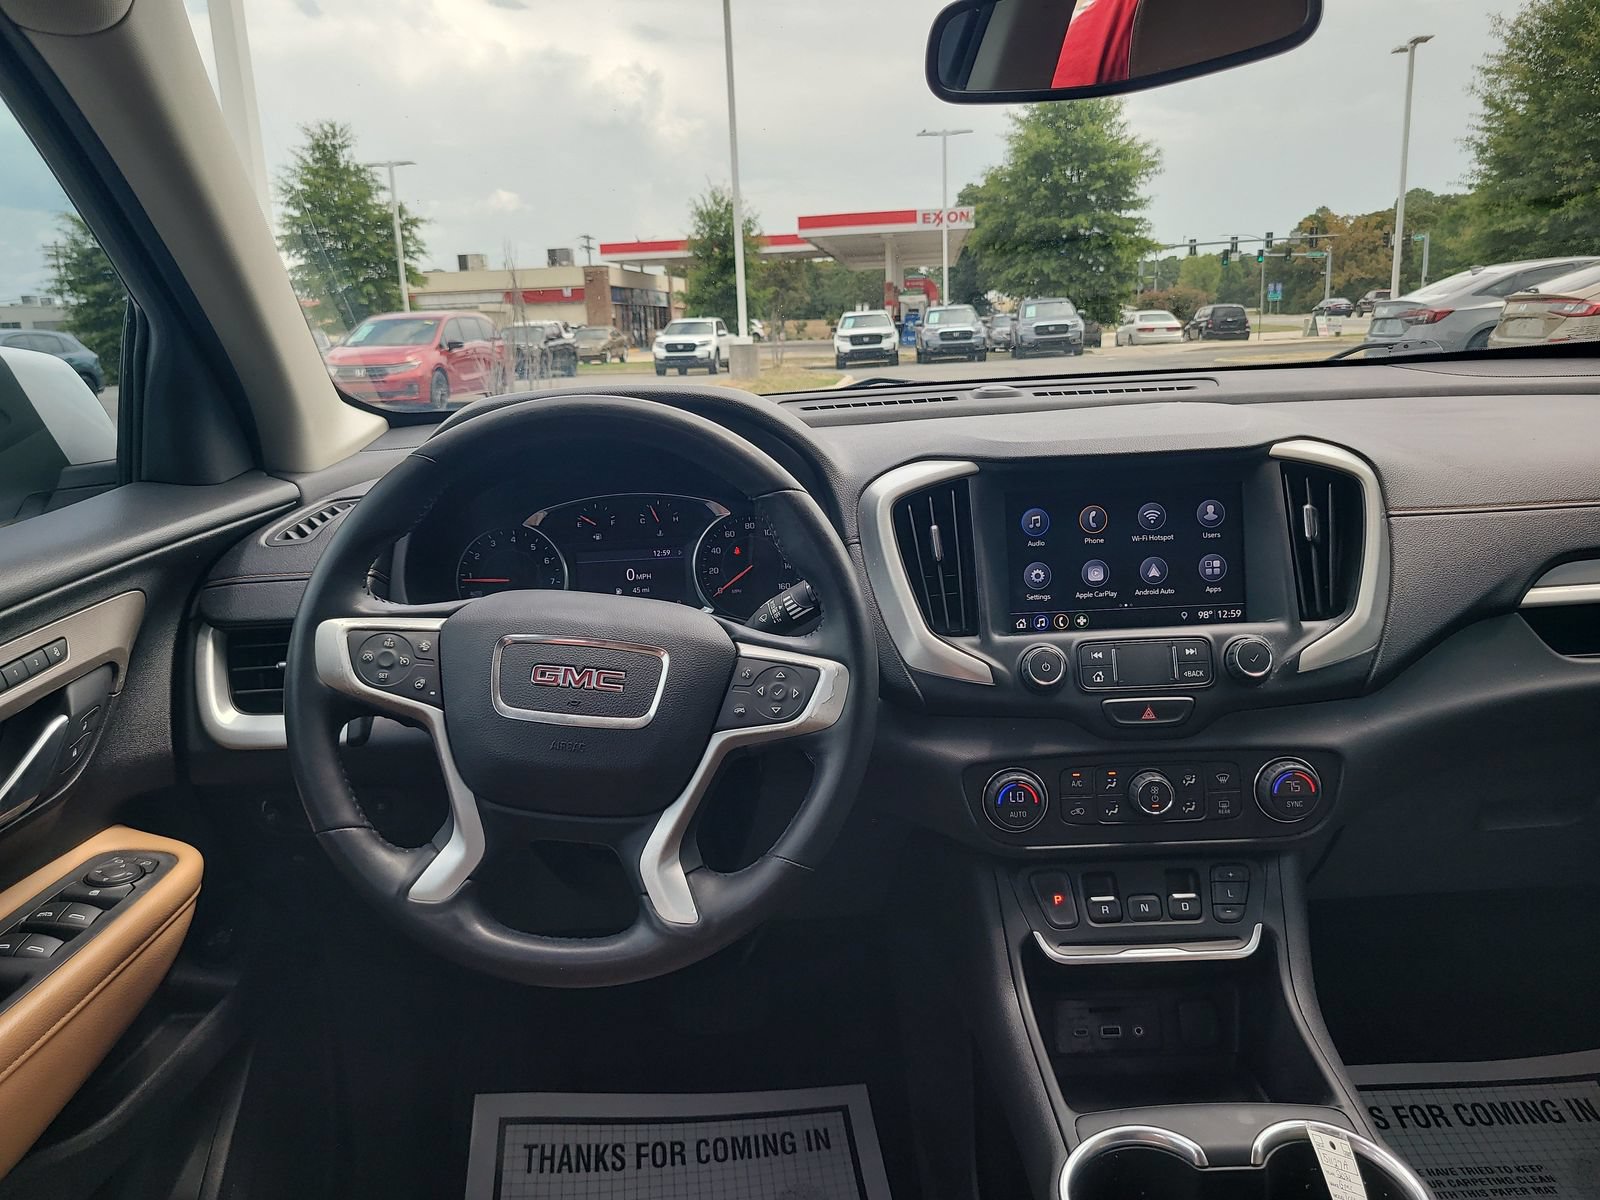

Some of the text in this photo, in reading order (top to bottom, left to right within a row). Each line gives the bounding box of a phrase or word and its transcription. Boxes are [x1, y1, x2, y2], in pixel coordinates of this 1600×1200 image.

[725, 530, 735, 538] 60
[1148, 534, 1174, 543] Hotspot
[1202, 531, 1221, 539] Users
[1027, 540, 1046, 548] Audio
[1084, 537, 1105, 545] Phone
[626, 568, 635, 581] 0
[709, 567, 719, 575] 20
[1075, 590, 1118, 600] Apple CarPlay
[1134, 588, 1175, 597] Android Auto
[1205, 586, 1222, 595] Apps
[1025, 593, 1052, 602] Settings
[1197, 609, 1242, 620] 98° 12:59
[531, 664, 626, 693] GMC
[1071, 779, 1083, 788] A/C
[1285, 780, 1301, 792] 75
[1286, 800, 1303, 808] SYNC
[1009, 810, 1027, 818] AUTO
[1054, 895, 1062, 905] P
[1101, 905, 1110, 914] R
[1140, 903, 1149, 912] N
[1181, 902, 1190, 912] D
[1394, 1104, 1454, 1130] FOR
[1451, 1099, 1563, 1128] COMING
[1563, 1097, 1600, 1122] IN
[524, 1127, 832, 1174] THANKS FOR COMING IN
[1425, 1167, 1458, 1177] HAVE
[1458, 1166, 1495, 1176] TRIED
[1495, 1165, 1513, 1174] TO
[1514, 1164, 1544, 1173] KEEP
[1447, 1176, 1517, 1188] CARPETING
[1517, 1174, 1557, 1184] CLEAN
[1458, 1189, 1490, 1199] THIS
[1492, 1187, 1530, 1197] PAPER
[1531, 1186, 1558, 1195] MAT
